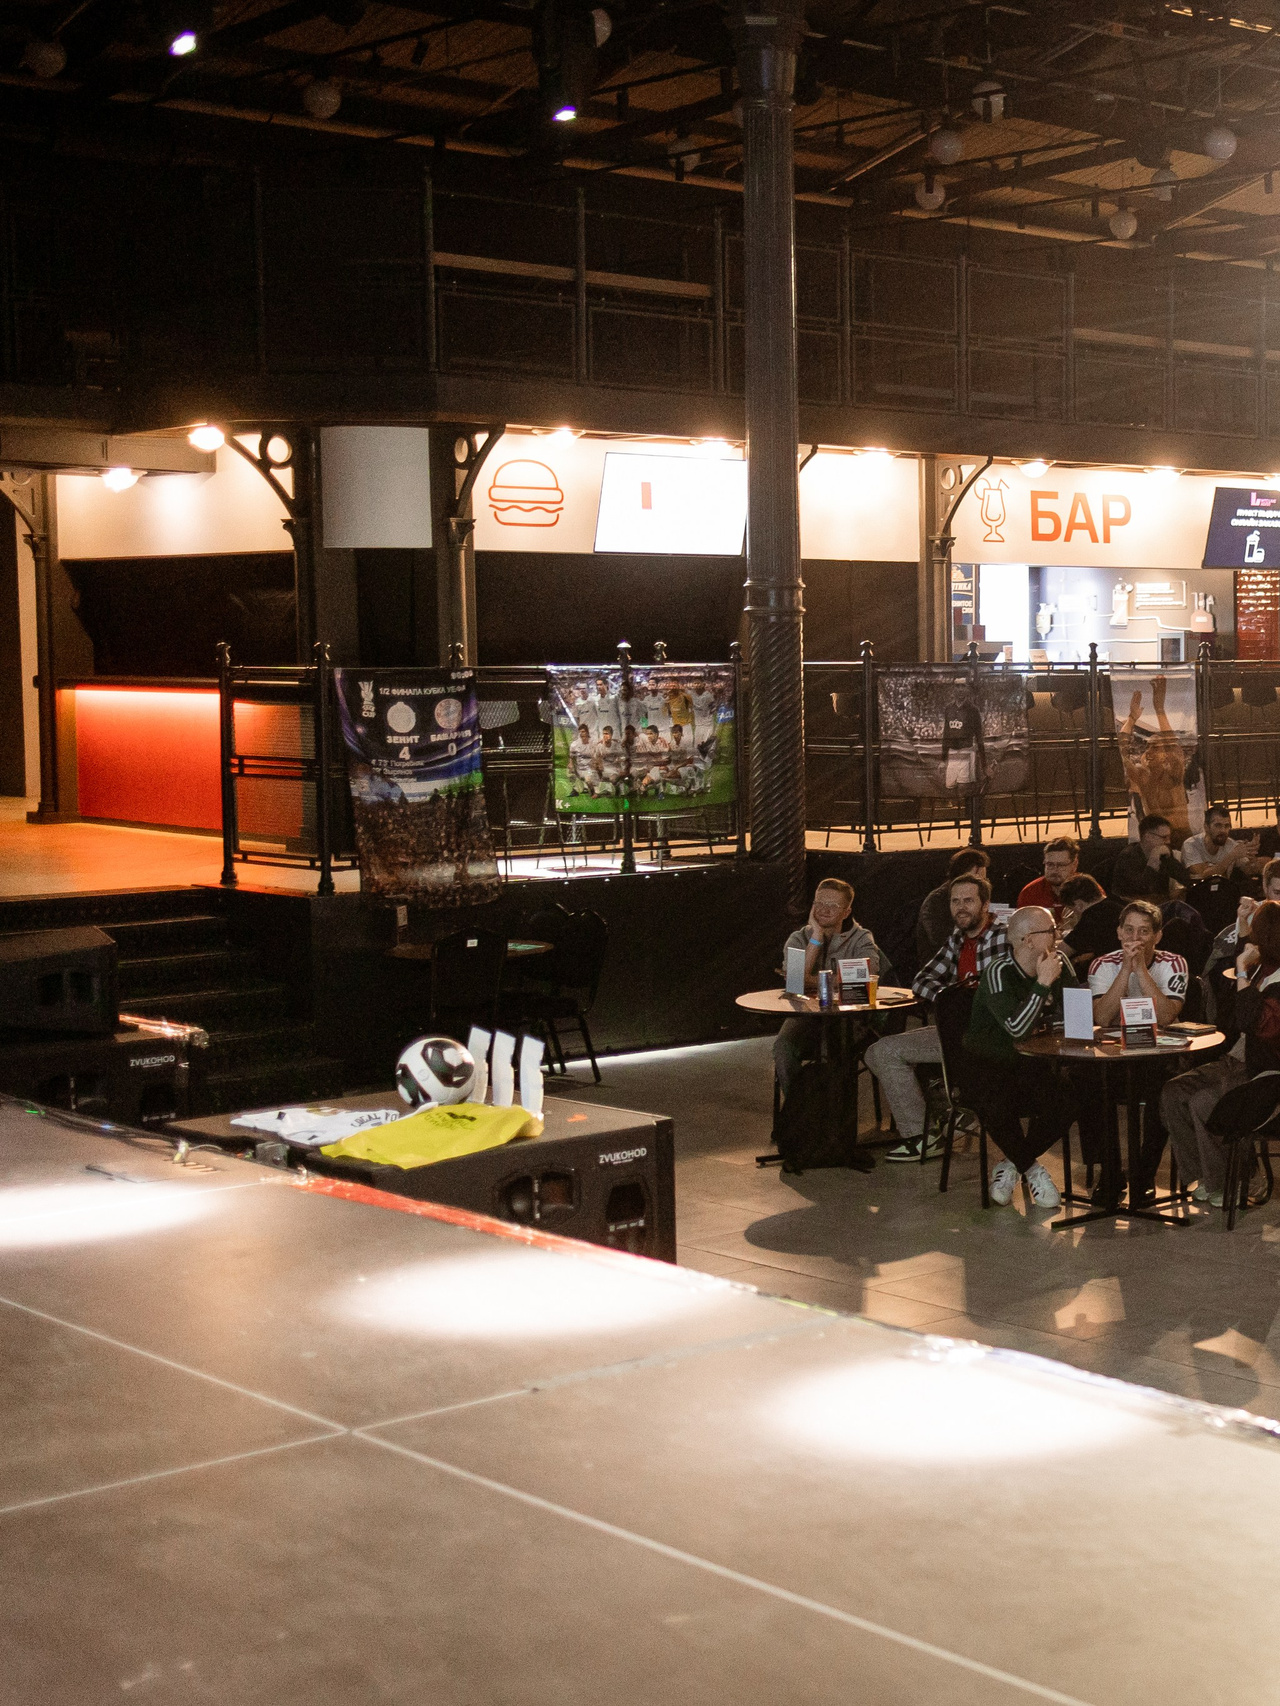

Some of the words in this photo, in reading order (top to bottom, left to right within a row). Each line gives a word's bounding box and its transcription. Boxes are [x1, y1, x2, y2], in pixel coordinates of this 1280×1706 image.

[1030, 490, 1132, 544] БАР
[379, 687, 390, 696] 1/2
[391, 687, 422, 696] ФИНАЛА
[422, 686, 446, 695] КУБКА
[386, 735, 420, 744] ЗЕНИТ
[398, 746, 411, 760] 4
[447, 742, 458, 756] 0
[130, 1055, 175, 1067] ZVUKOHOD
[599, 1147, 647, 1164] ZVUKOHOD
